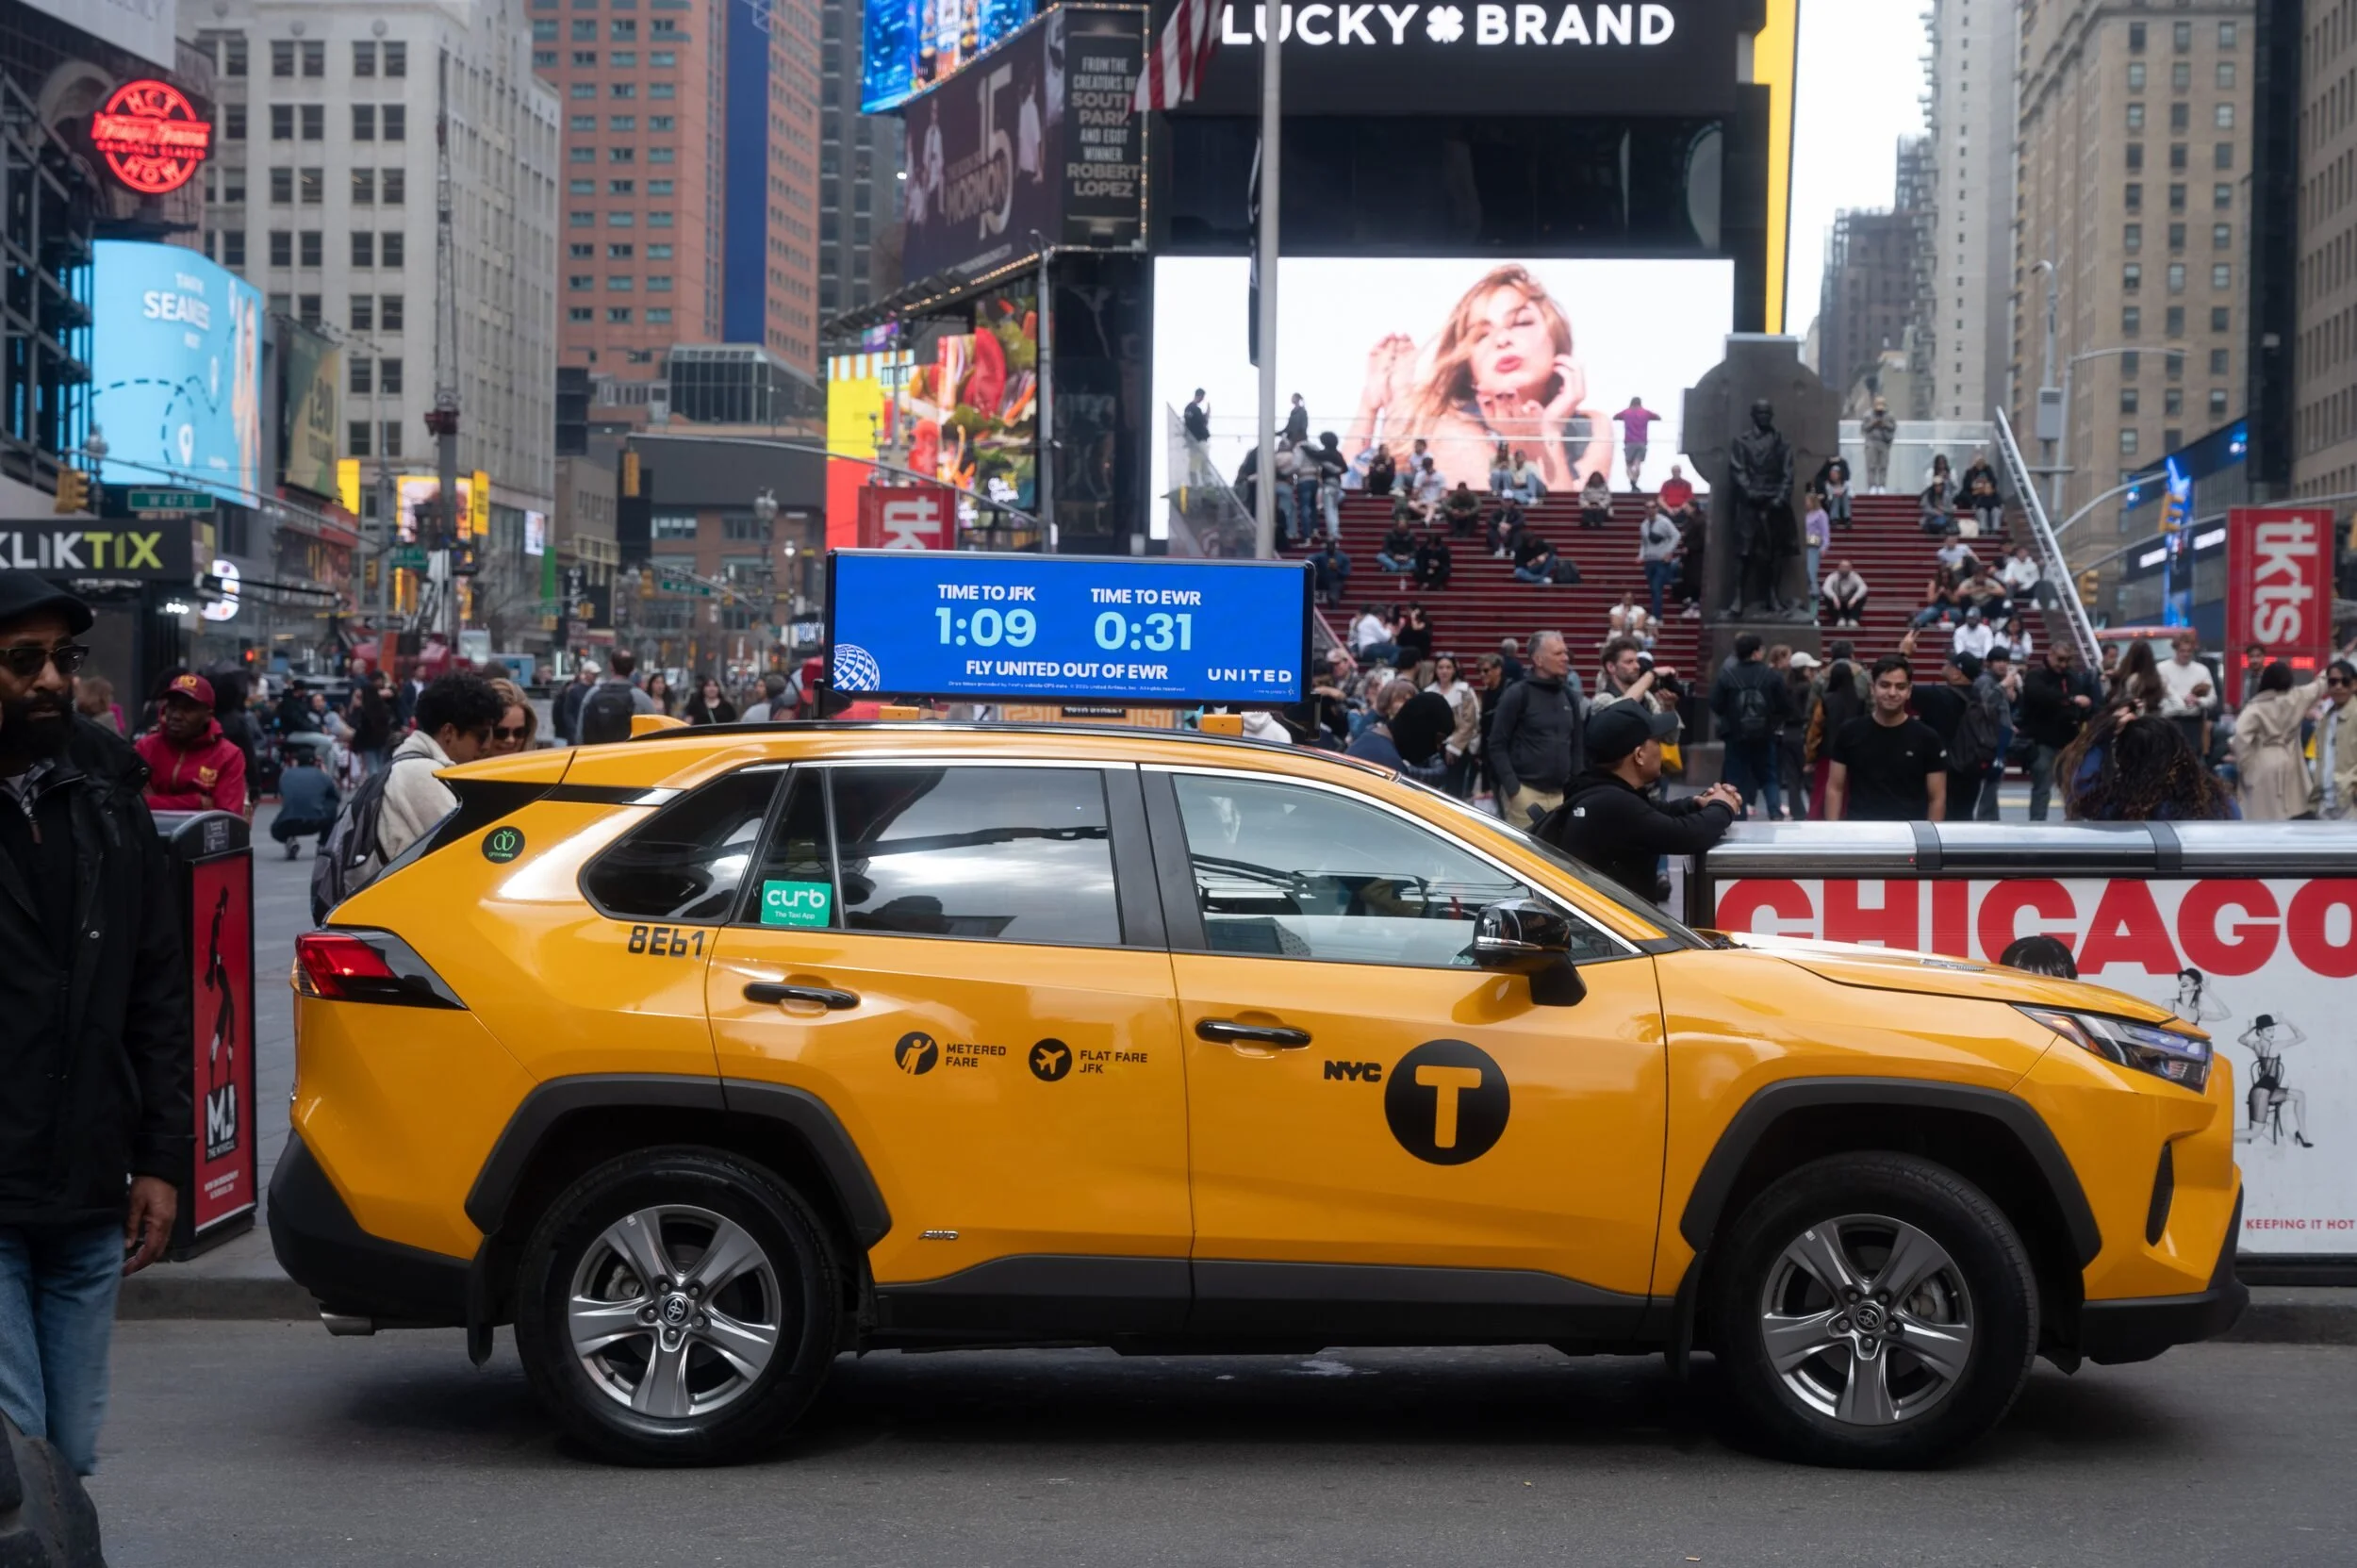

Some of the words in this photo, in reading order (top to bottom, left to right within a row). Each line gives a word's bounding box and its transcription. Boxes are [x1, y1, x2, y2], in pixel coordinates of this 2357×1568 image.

[1222, 3, 1419, 45] LUCKY
[1476, 3, 1675, 45] BRAND
[1083, 146, 1123, 162] WINNER
[1066, 163, 1140, 180] ROBERT
[1073, 181, 1134, 198] LOPEZ
[2252, 516, 2318, 644] tkts
[938, 585, 980, 601] TIME
[981, 586, 1005, 601] TO
[1007, 586, 1035, 602] JFK
[1091, 588, 1131, 603] TIME
[1134, 589, 1159, 604] TO
[1162, 590, 1201, 605] EWR
[934, 607, 1036, 647] 1:09
[1095, 611, 1192, 652] 0:31
[966, 661, 995, 676] FLY
[997, 662, 1058, 677] UNITED
[1063, 663, 1100, 678] OUT
[1102, 664, 1126, 679] OF
[1129, 665, 1168, 680] EWR
[1208, 668, 1293, 683] UNITED
[766, 889, 826, 909] curb
[1716, 879, 2357, 979] CHICAGO
[947, 1043, 1007, 1056] METERED
[1080, 1049, 1112, 1062] FLAT
[1115, 1051, 1148, 1063] FARE
[946, 1057, 979, 1067] FARE
[1079, 1064, 1104, 1074] JFK
[1324, 1060, 1382, 1083] NYC
[1415, 1064, 1482, 1148] T
[207, 1084, 236, 1147] MJ
[2246, 1219, 2306, 1230] KEEPING
[2311, 1219, 2323, 1230] IT
[2327, 1219, 2355, 1230] HOT
